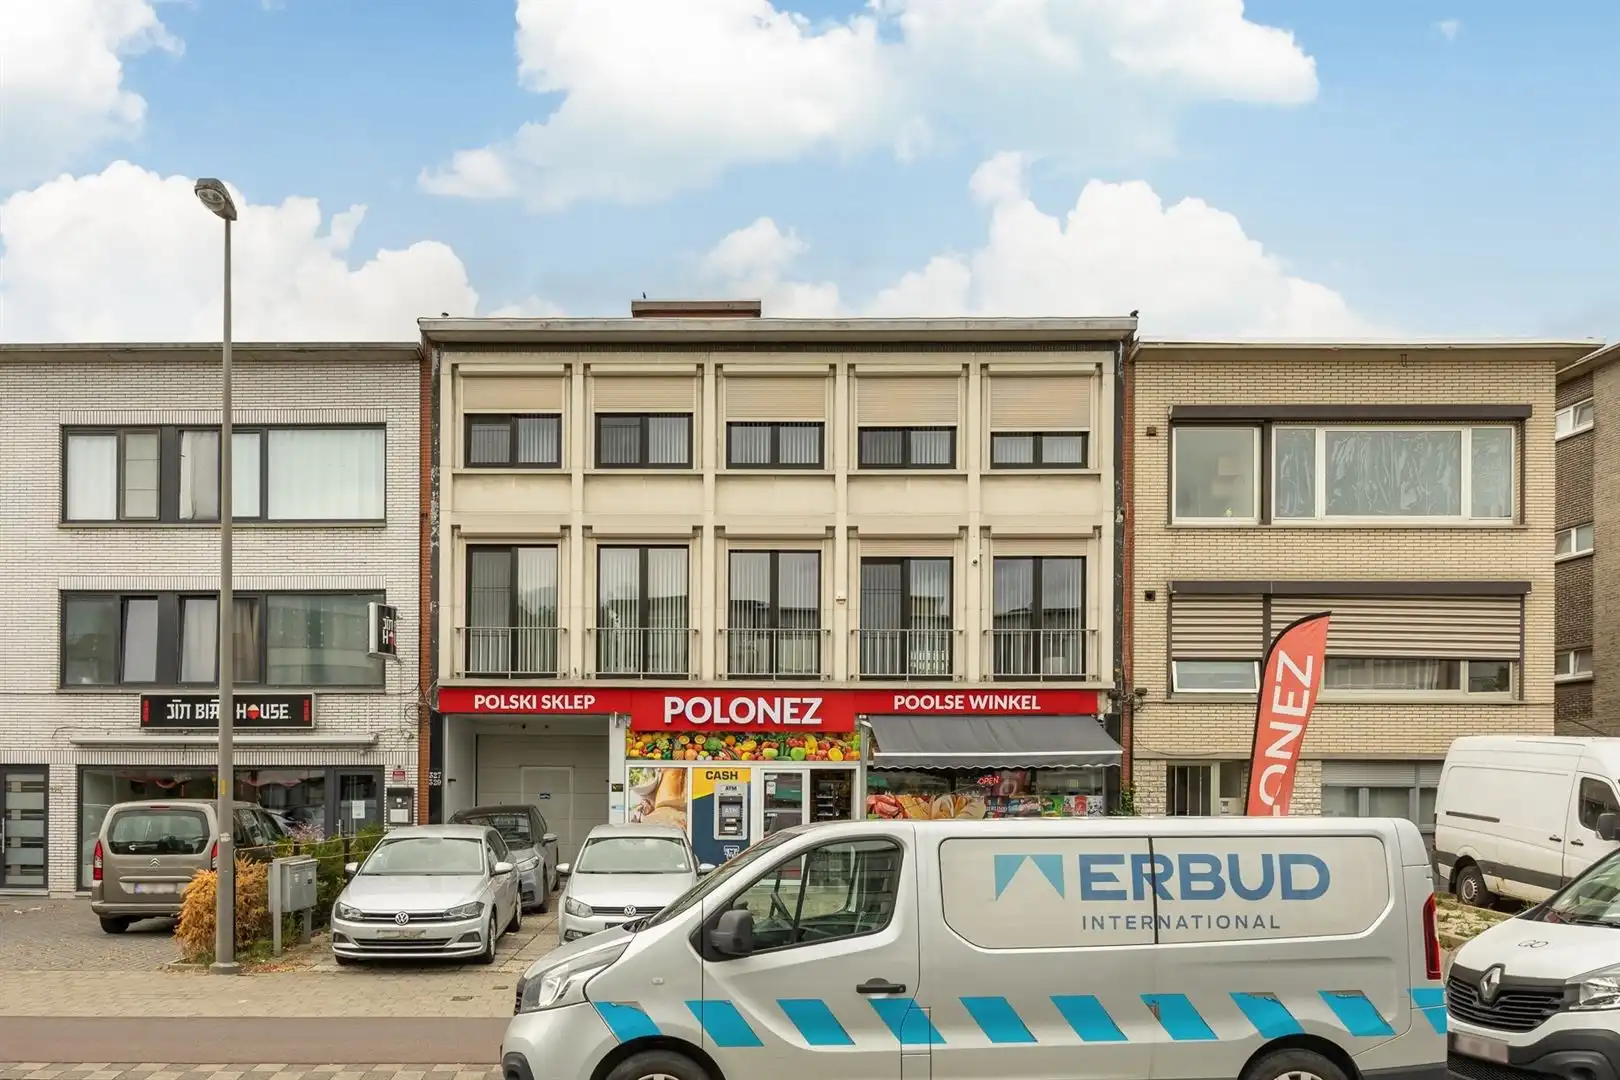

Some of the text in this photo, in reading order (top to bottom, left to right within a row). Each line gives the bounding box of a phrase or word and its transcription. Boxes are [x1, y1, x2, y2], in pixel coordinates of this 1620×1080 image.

[474, 694, 596, 710] POLSKI SKLEP
[663, 696, 823, 724] POLONEZ
[893, 695, 1041, 710] POOLSE WINKEL
[705, 770, 738, 781] CASH
[977, 775, 1000, 786] OPEN
[1078, 853, 1331, 901] ERBUD
[1082, 914, 1281, 931] INTERNATIONAL
